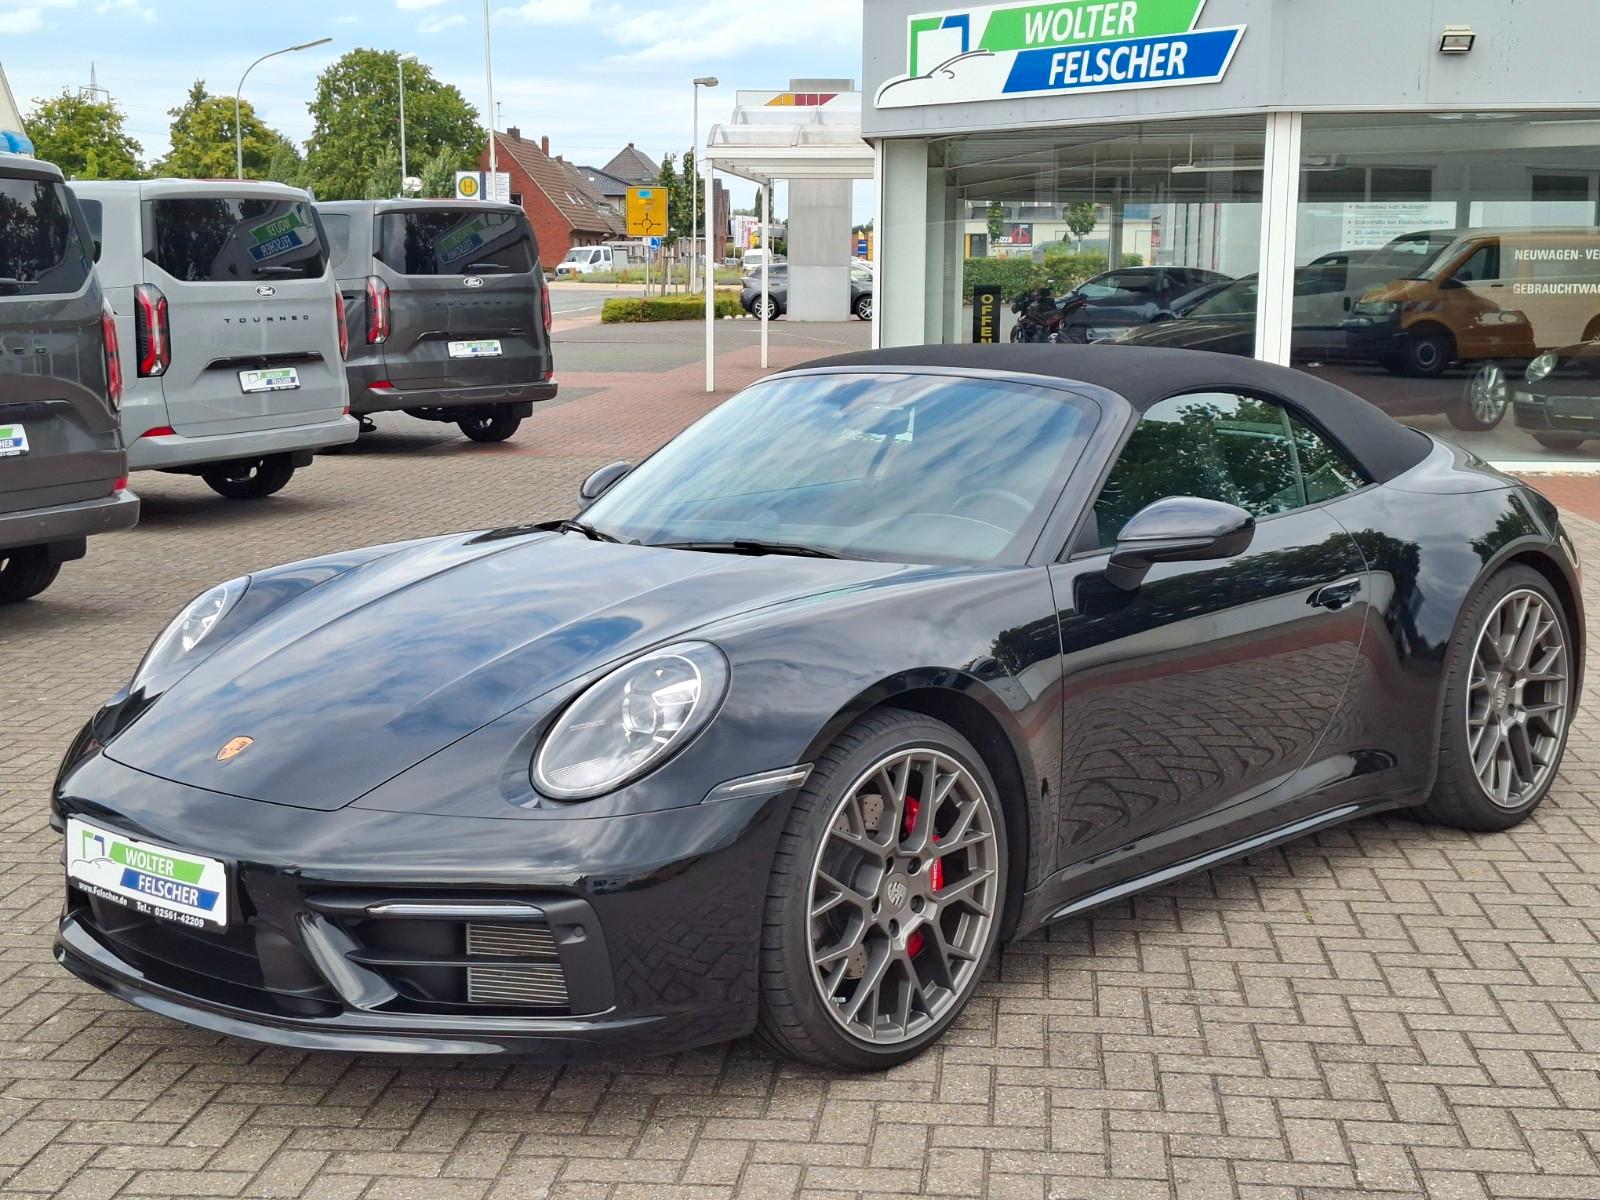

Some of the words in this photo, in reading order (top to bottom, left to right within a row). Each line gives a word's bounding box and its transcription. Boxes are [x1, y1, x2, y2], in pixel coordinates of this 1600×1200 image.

[1025, 1, 1137, 44] WOLTER
[1048, 41, 1188, 87] FELSCHER
[1514, 249, 1584, 261] NEUWAGEN-
[1585, 249, 1600, 260] VE
[224, 315, 309, 324] TOURNEO
[124, 847, 175, 877] WOLTER
[79, 882, 128, 906] www.Felscher.de
[136, 901, 151, 914] Tel.:
[154, 908, 205, 928] 02561-42209
[138, 874, 199, 906] FELSCHER
